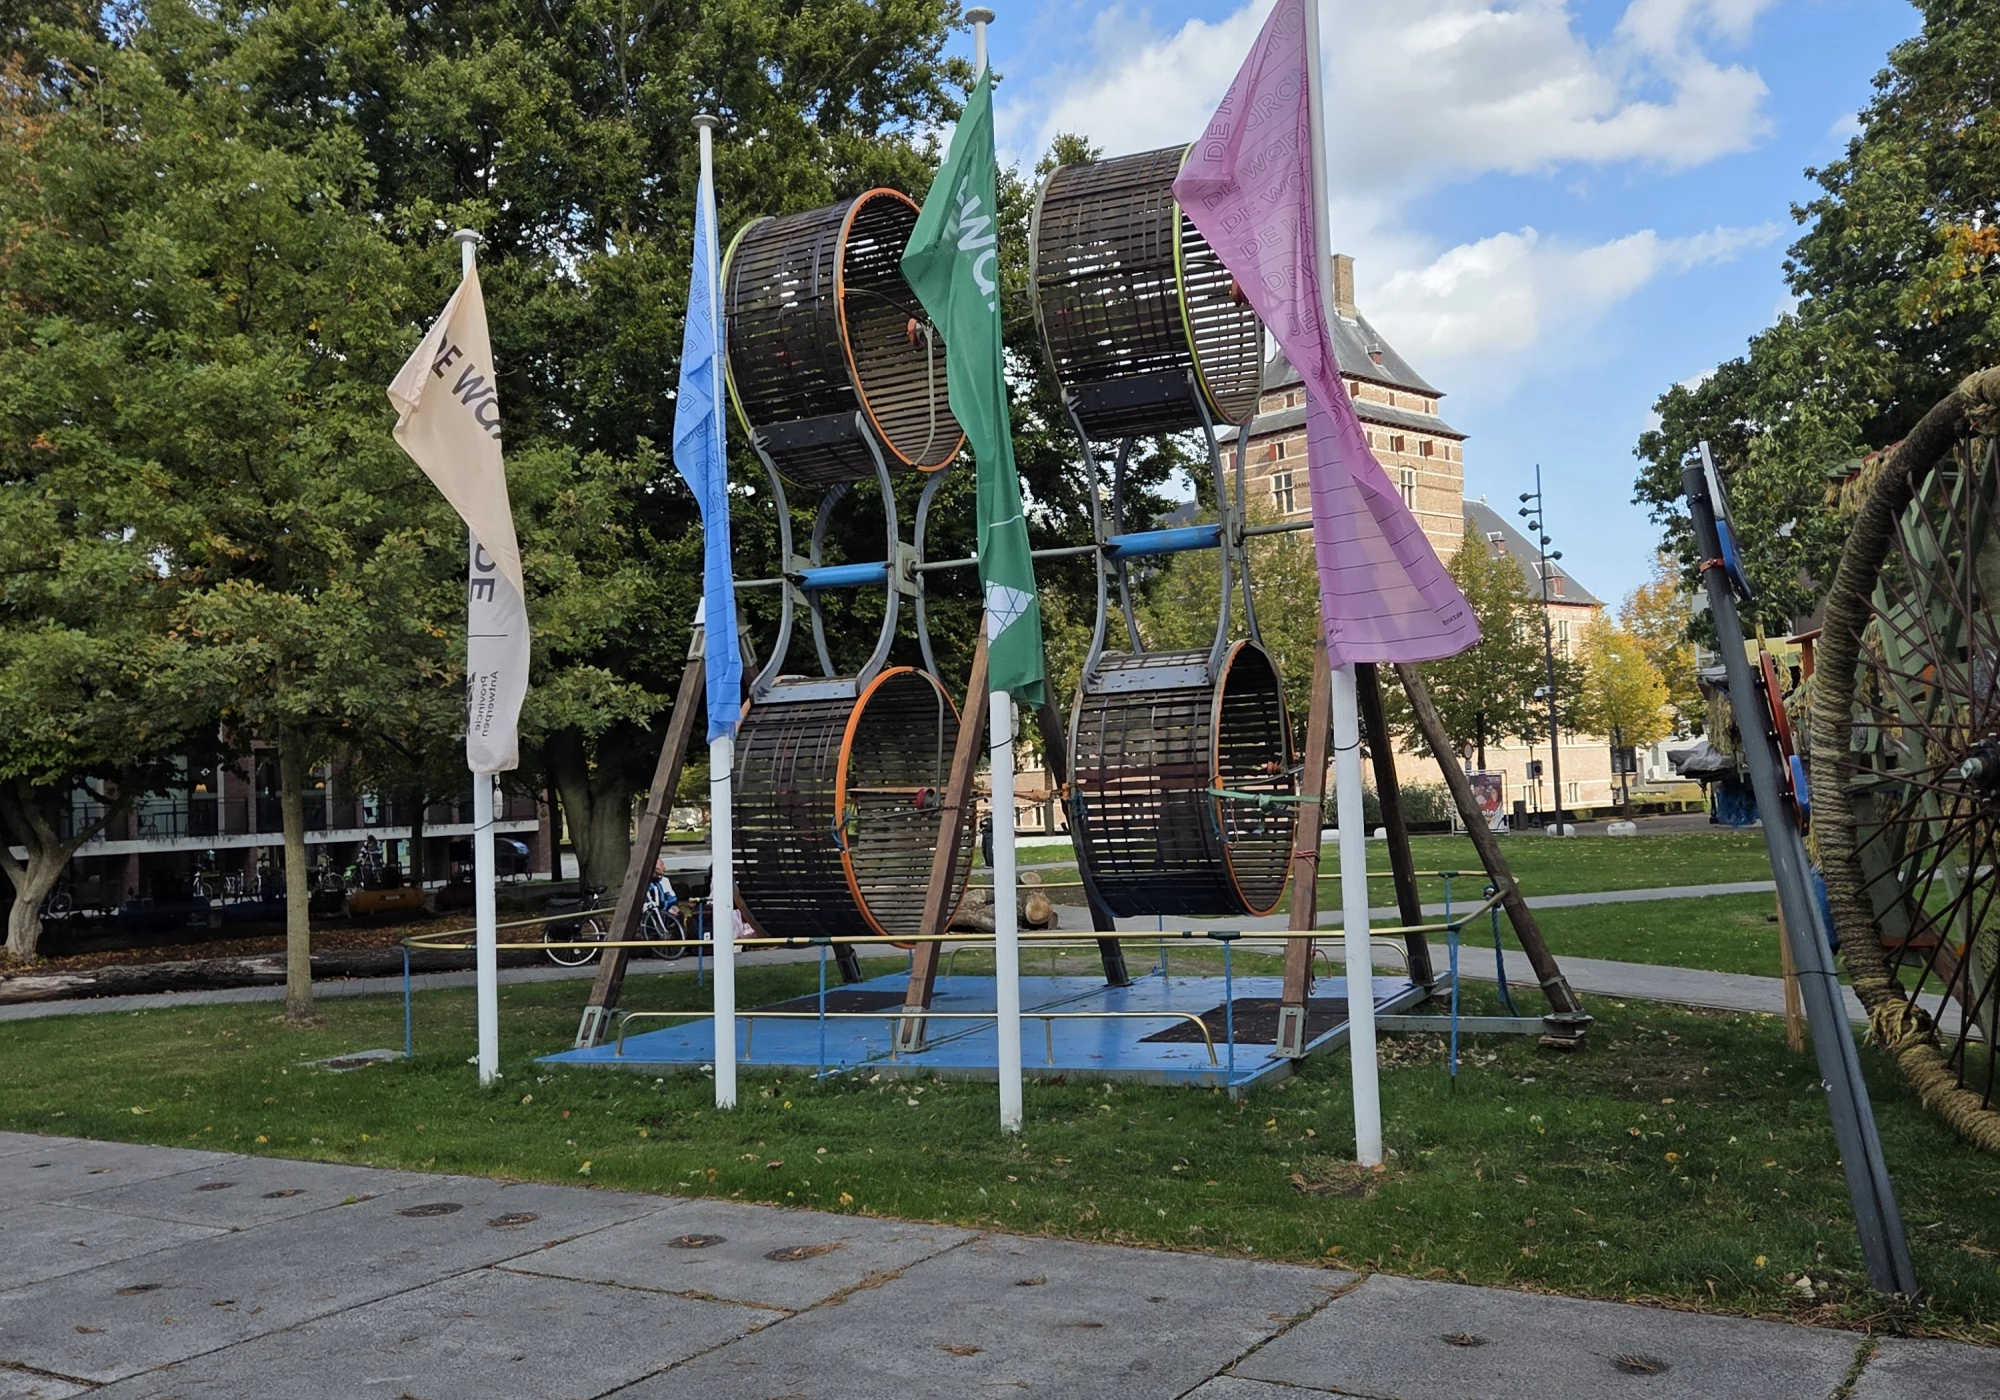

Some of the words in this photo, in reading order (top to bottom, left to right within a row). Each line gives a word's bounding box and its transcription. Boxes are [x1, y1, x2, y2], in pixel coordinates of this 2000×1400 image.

[1202, 176, 1241, 212] DE
[1220, 202, 1262, 235] DE
[1240, 226, 1284, 260] DE
